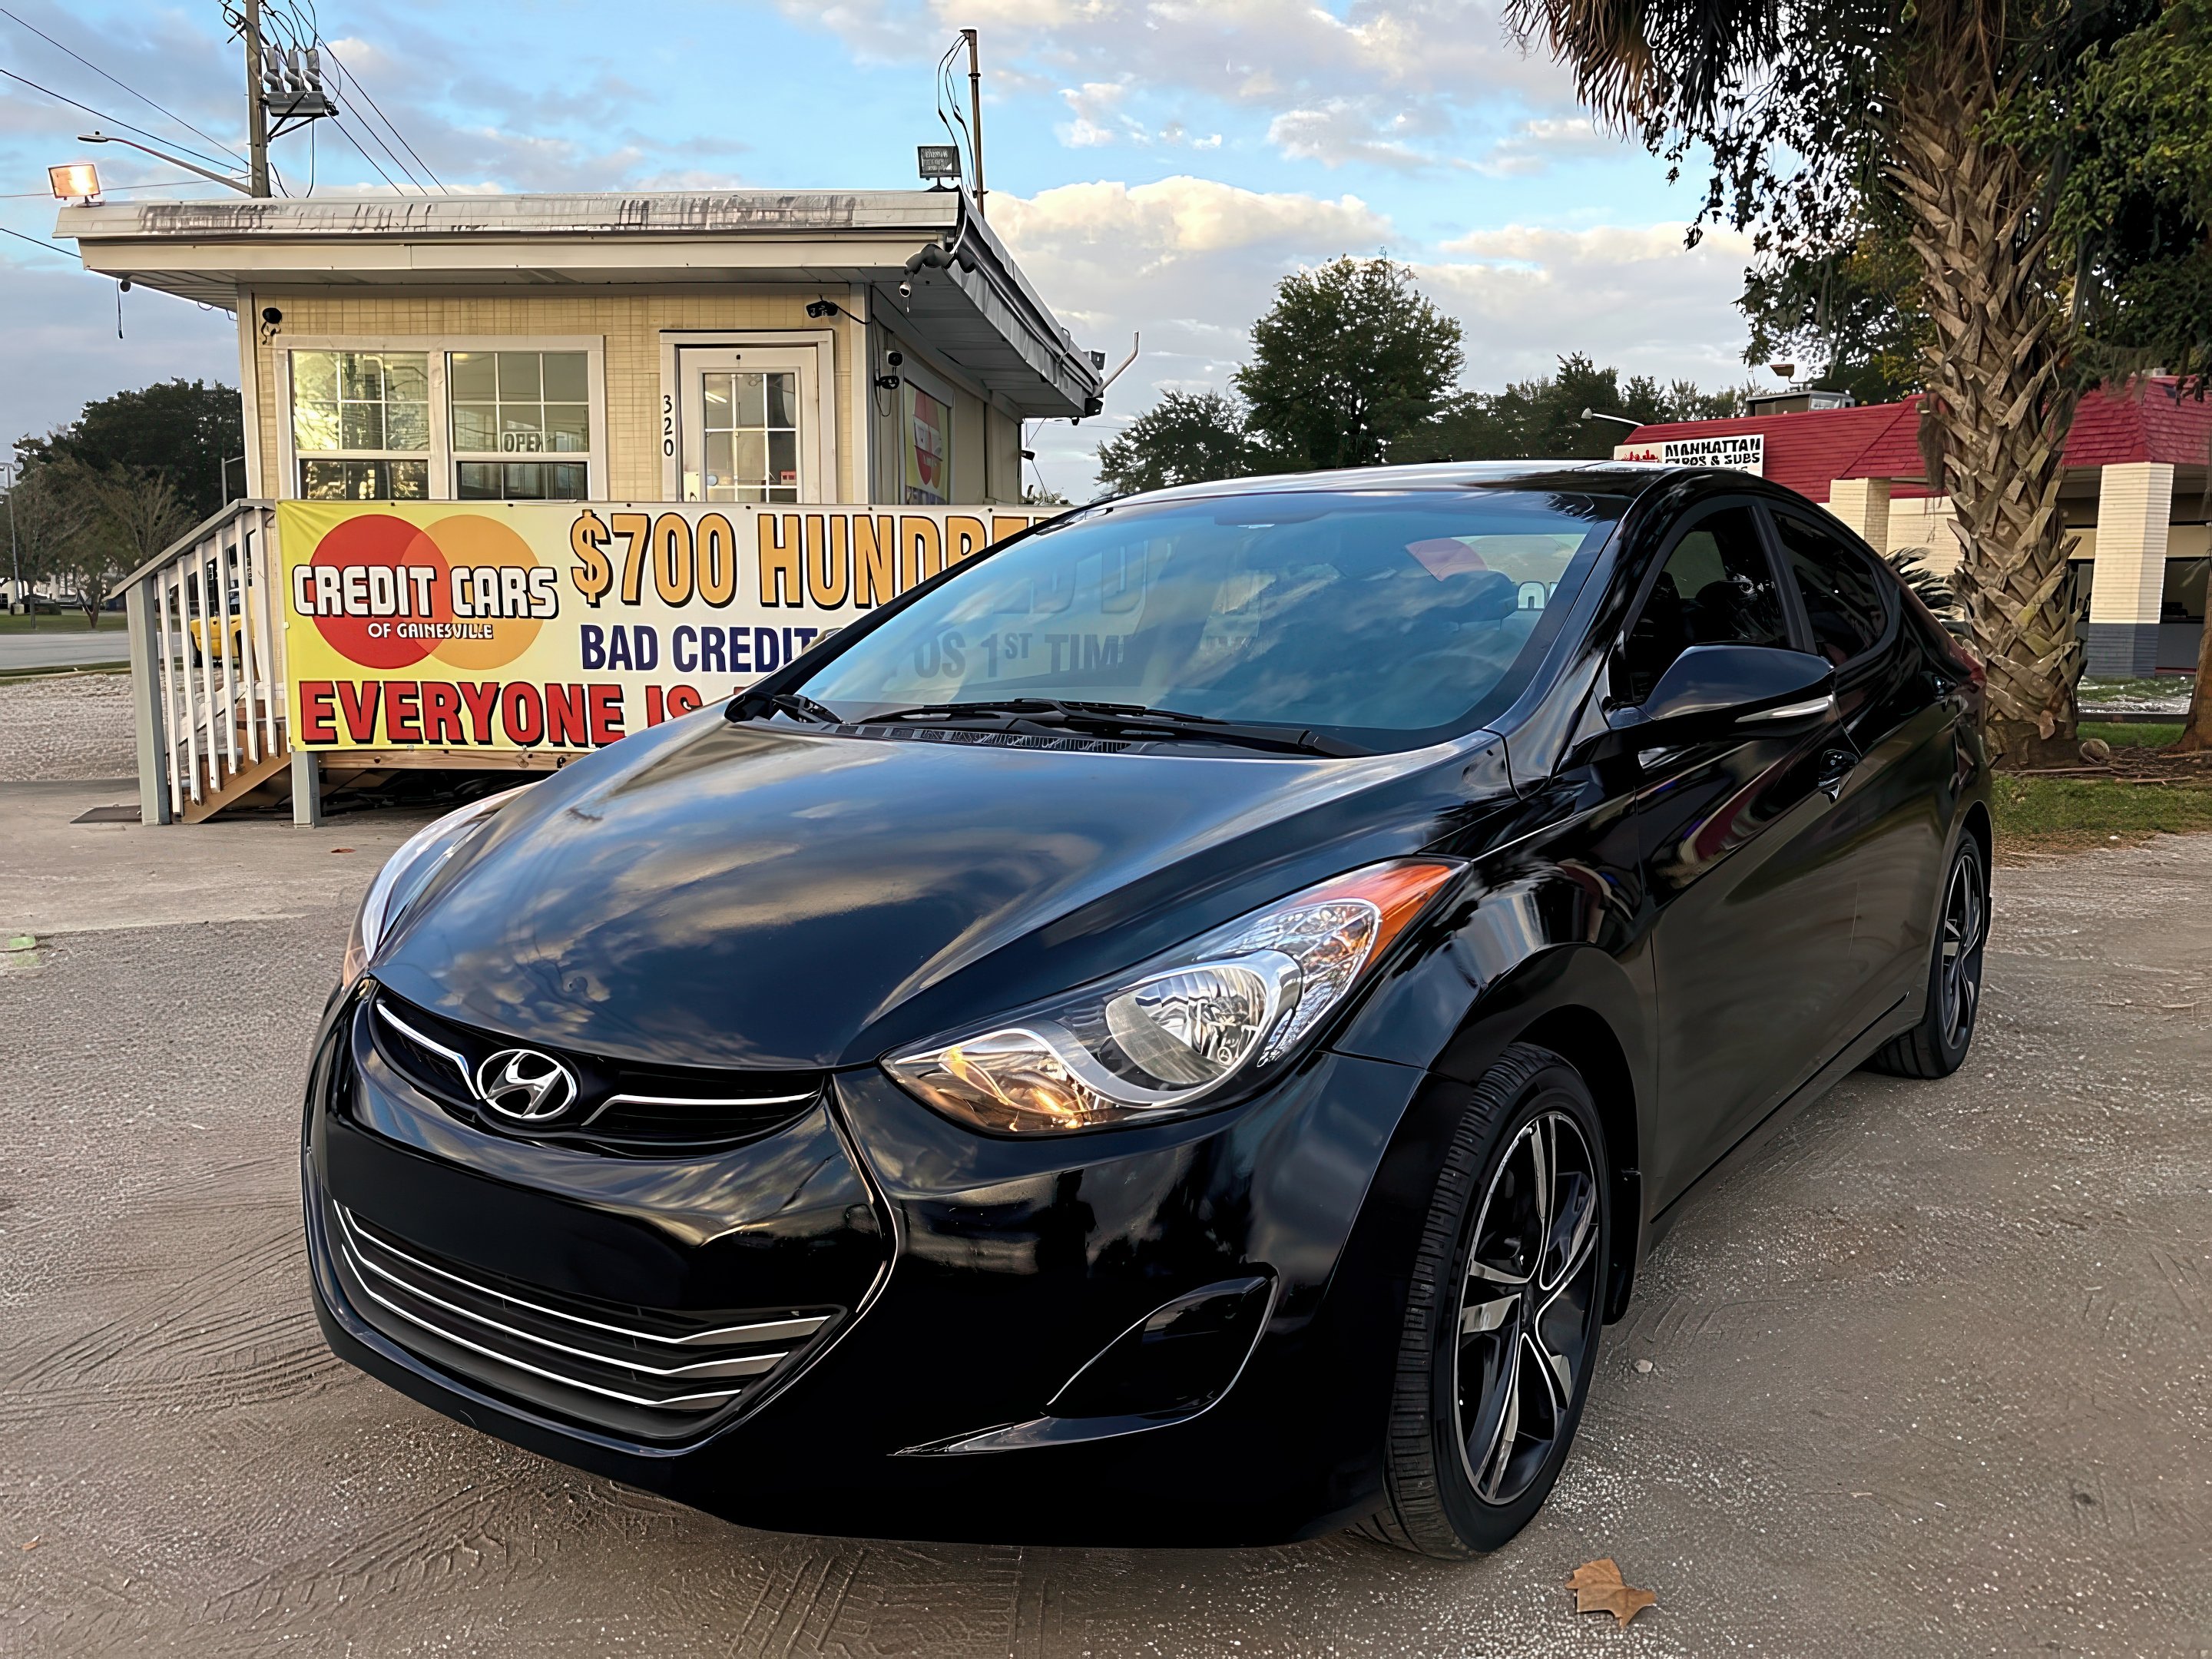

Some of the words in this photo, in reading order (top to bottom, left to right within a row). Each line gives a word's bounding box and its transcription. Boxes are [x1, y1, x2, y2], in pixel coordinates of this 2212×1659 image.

[663, 394, 674, 457] 320
[1665, 438, 1760, 457] MANHATTAN
[1710, 455, 1720, 466] &
[1724, 452, 1761, 465] SUBS
[570, 509, 737, 608] $700
[293, 565, 438, 618] CREDIT
[450, 566, 559, 618] CARS
[368, 623, 392, 638] OF
[396, 623, 494, 639] GAINESVILLE
[580, 624, 659, 671] BAD
[672, 625, 818, 673] CREDIT
[299, 680, 628, 747] EVERYONE
[644, 684, 703, 728] IS
